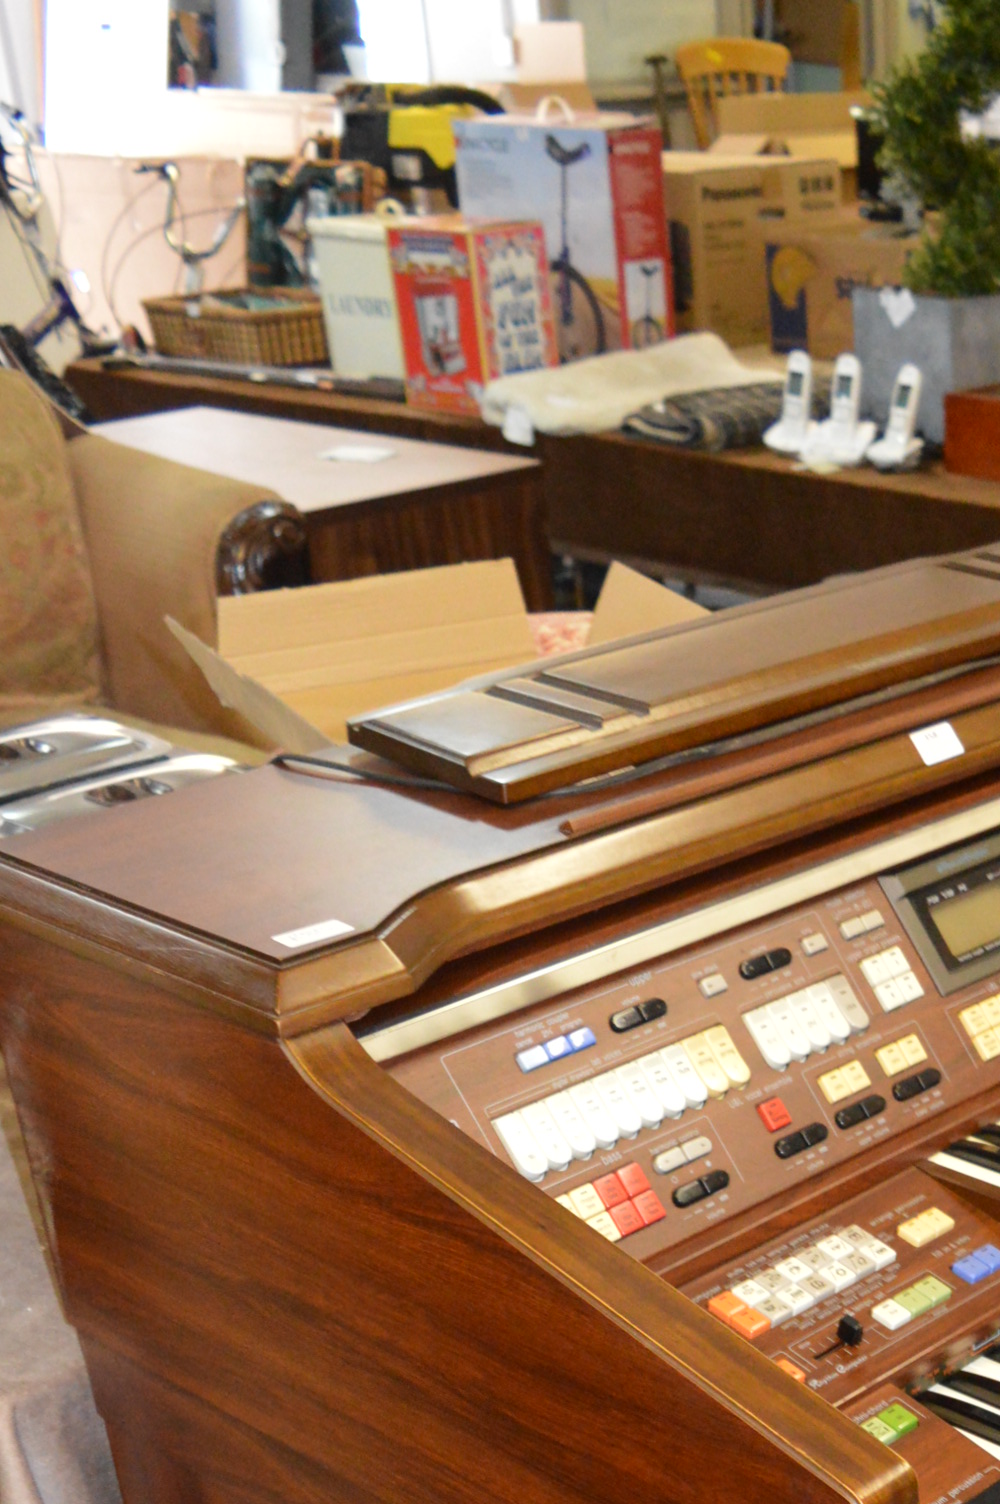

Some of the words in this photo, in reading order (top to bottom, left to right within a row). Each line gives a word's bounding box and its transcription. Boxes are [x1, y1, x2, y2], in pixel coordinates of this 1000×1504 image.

[328, 295, 393, 318] LAUNDRY
[600, 1150, 622, 1166] bass
[948, 1472, 984, 1499] percussion
